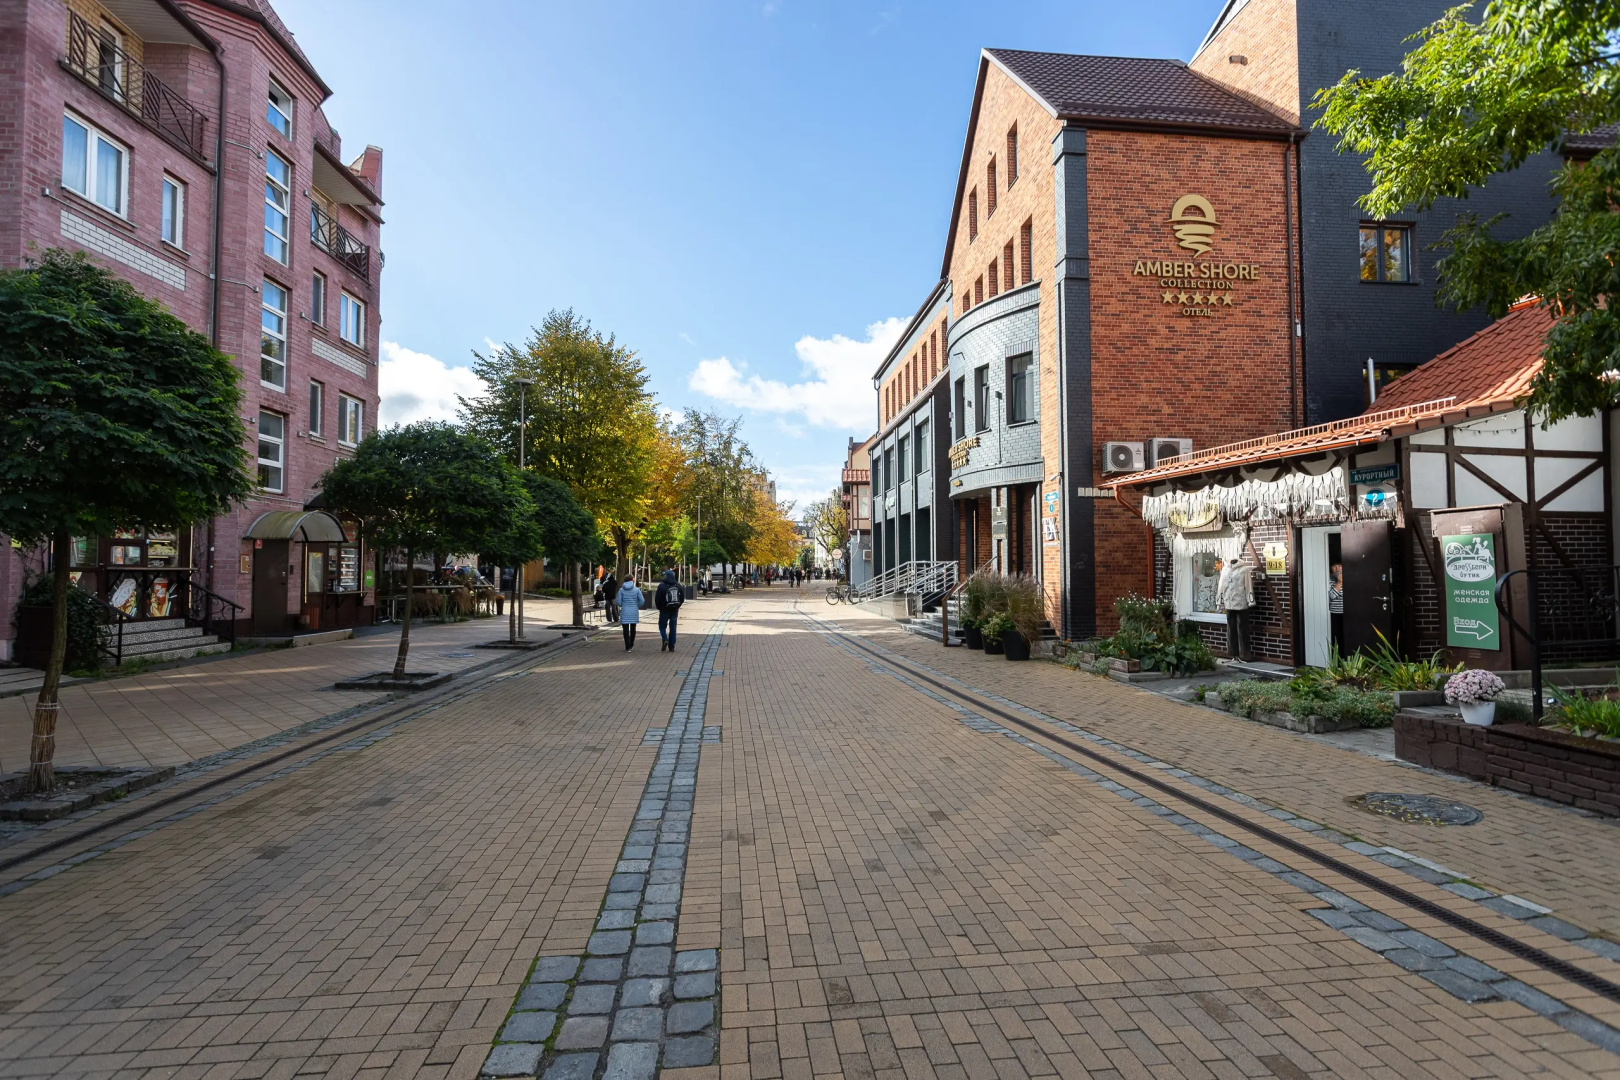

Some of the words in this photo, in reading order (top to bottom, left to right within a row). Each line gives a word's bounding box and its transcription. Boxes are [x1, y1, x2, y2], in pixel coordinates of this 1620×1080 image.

[1133, 260, 1195, 277] AMBER
[1200, 263, 1260, 280] SHORE
[1160, 278, 1234, 289] COLLECTION
[1183, 307, 1213, 317] ОТЕЛЬ
[1354, 469, 1394, 481] КУРОРТНЫЙ
[1372, 493, 1378, 503] 2
[1455, 596, 1489, 604] одежда
[1453, 616, 1476, 626] Вход
